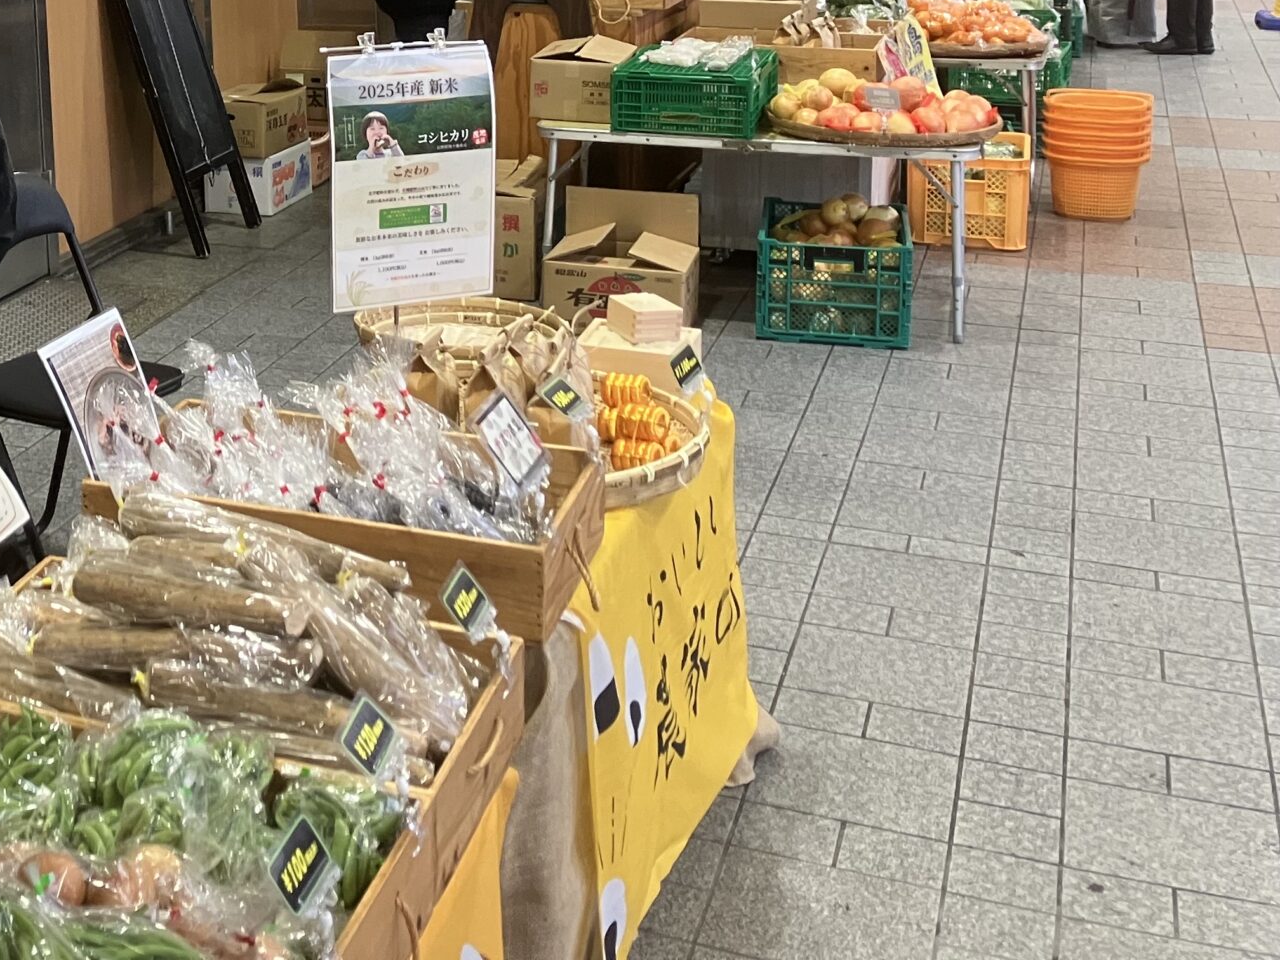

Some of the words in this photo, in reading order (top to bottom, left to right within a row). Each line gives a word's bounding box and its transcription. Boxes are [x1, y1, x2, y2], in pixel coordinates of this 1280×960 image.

[358, 80, 424, 99] 2025年産
[429, 77, 458, 95] 新米
[417, 128, 469, 144] コシヒカリ
[393, 166, 429, 178] こだわり
